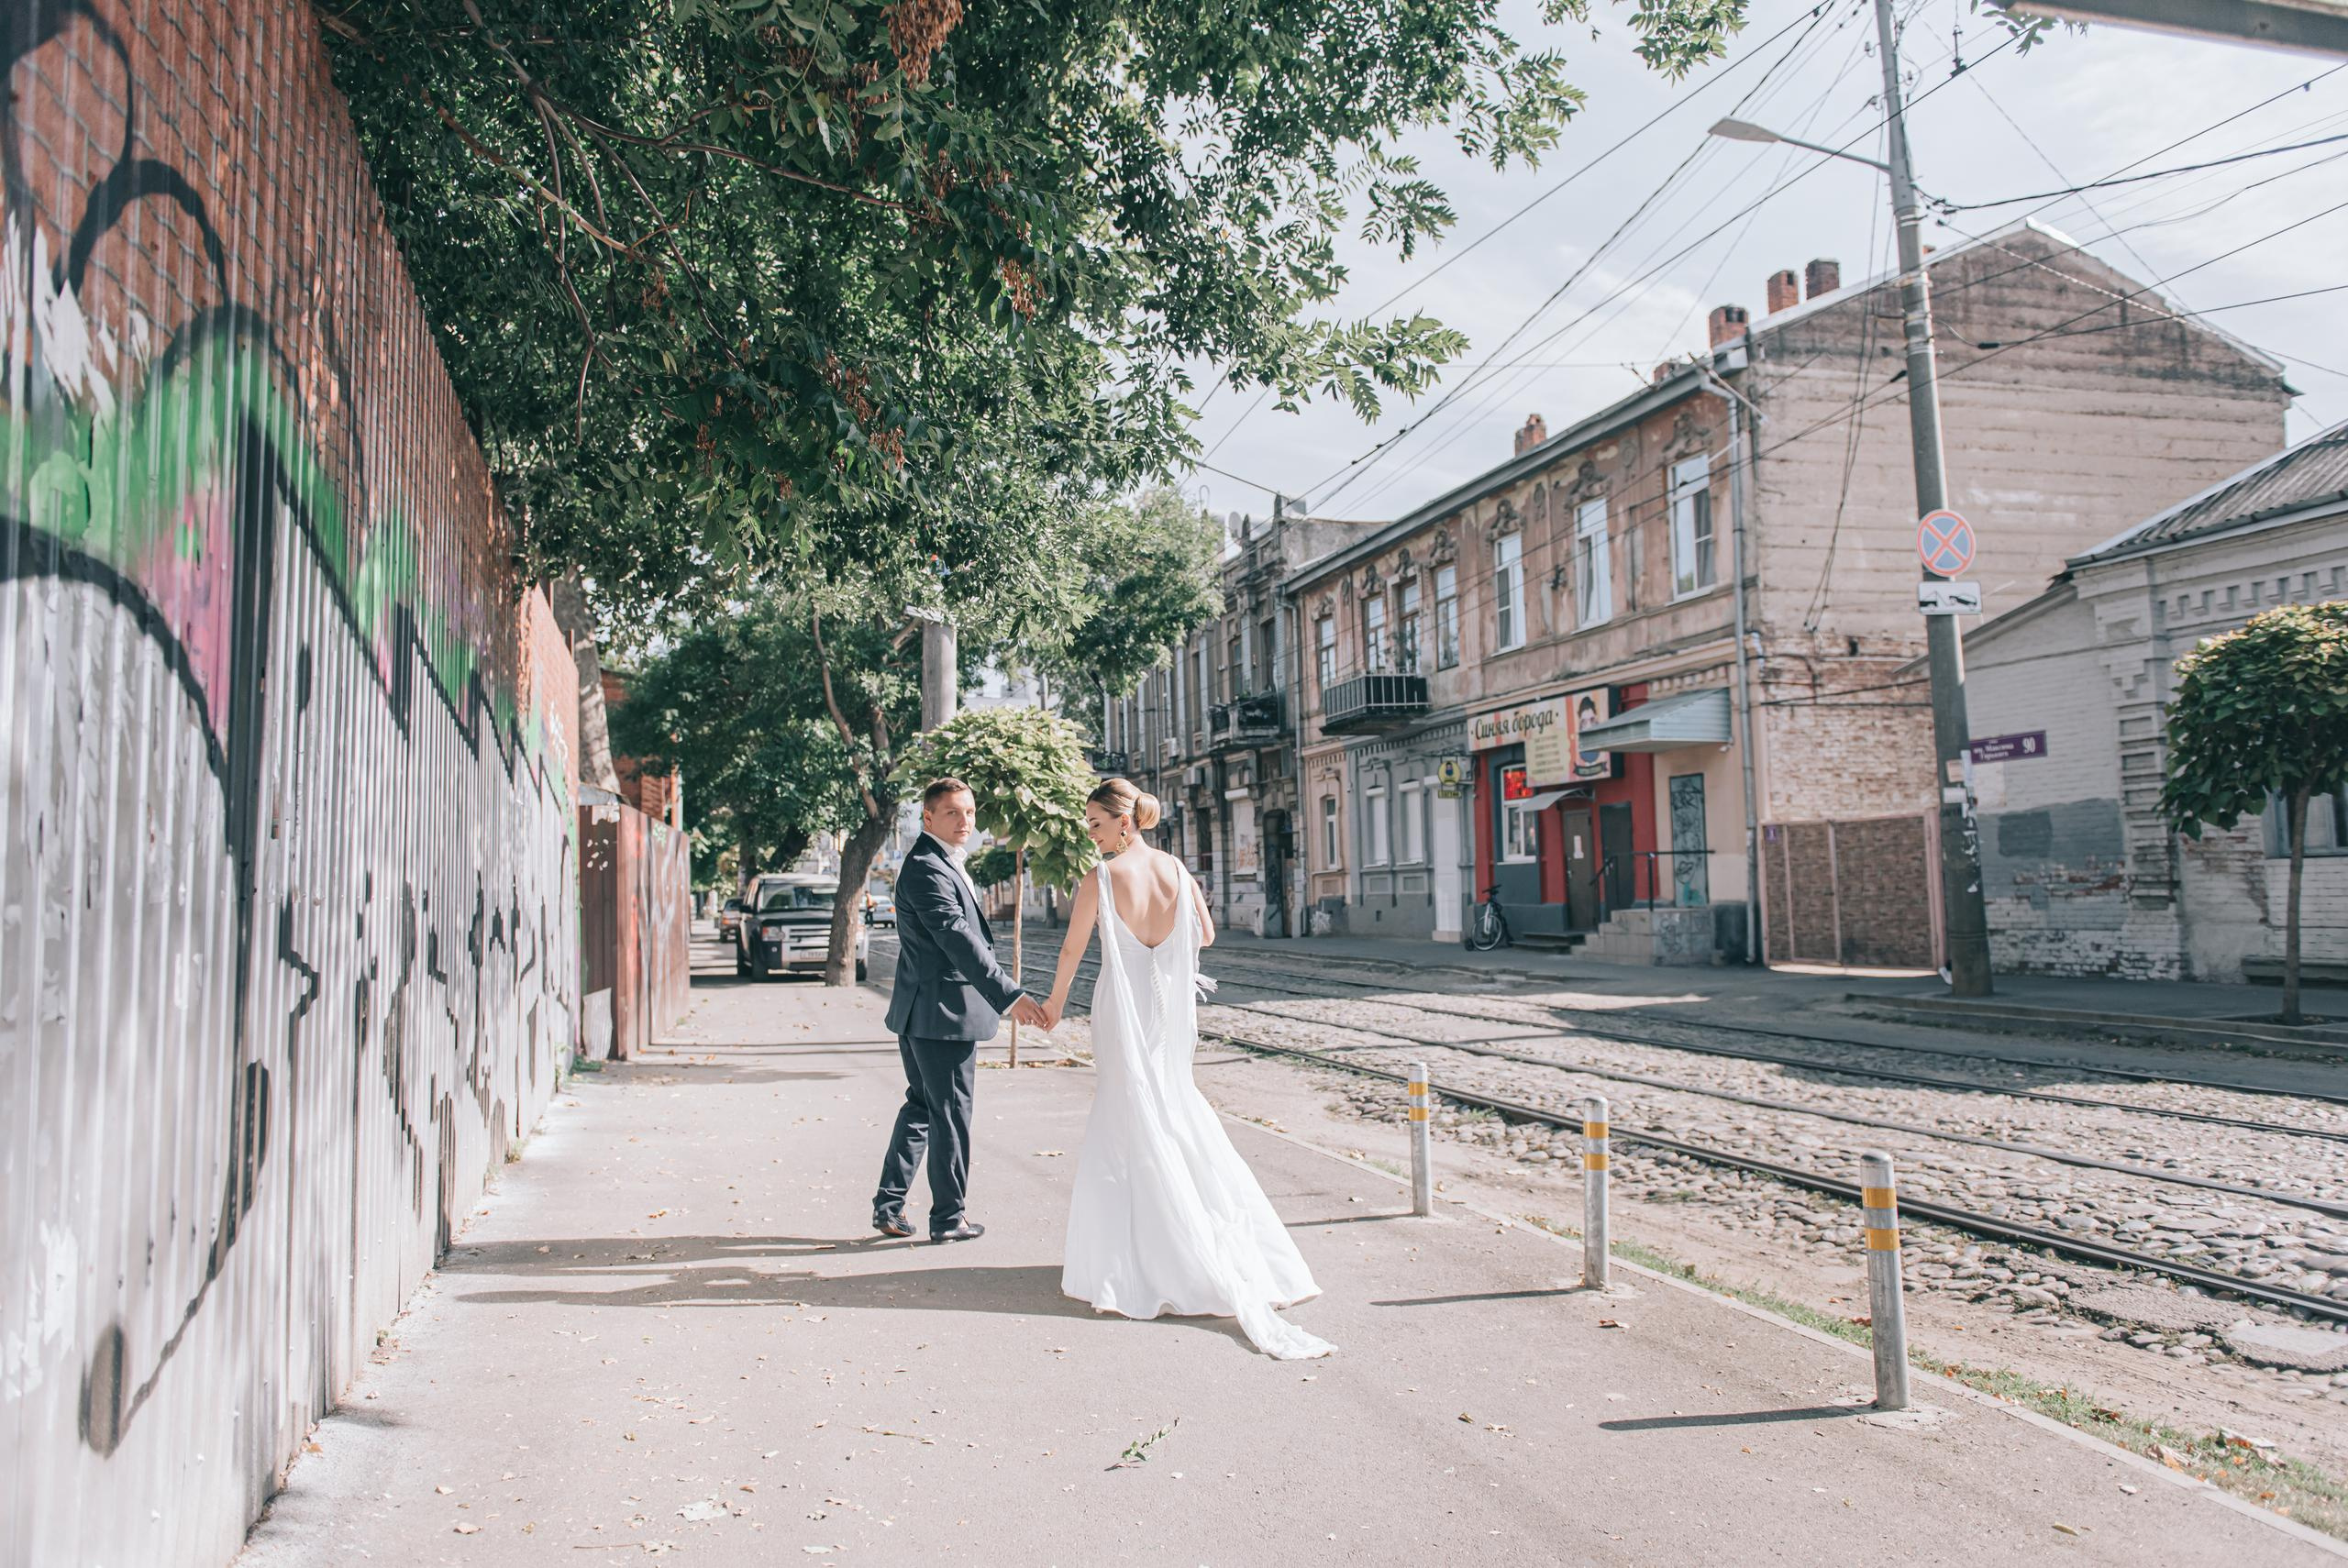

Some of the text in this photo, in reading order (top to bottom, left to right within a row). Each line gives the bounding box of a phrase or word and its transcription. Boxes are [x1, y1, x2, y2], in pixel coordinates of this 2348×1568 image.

[1476, 710, 1554, 740] Синяя борода
[2022, 736, 2035, 754] 90
